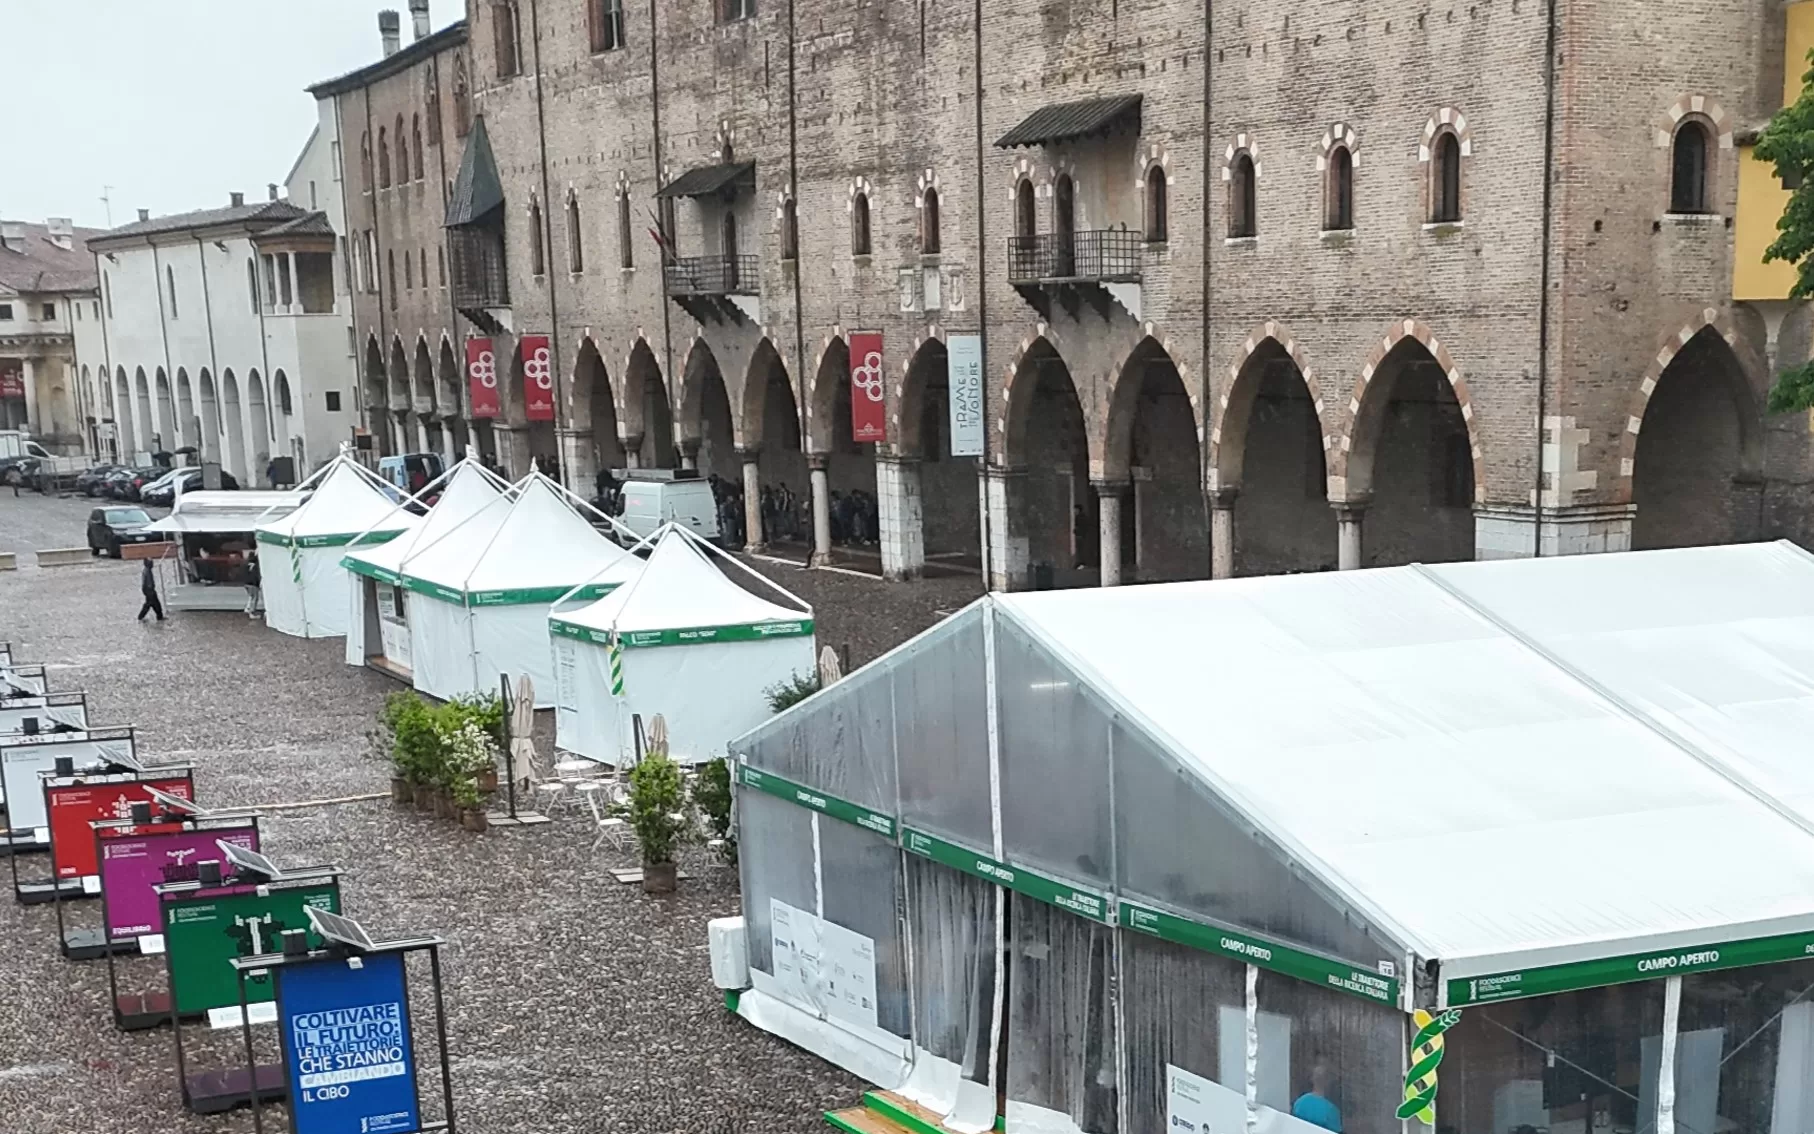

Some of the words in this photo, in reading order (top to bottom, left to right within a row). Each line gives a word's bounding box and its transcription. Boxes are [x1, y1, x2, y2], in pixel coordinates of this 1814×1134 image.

[976, 860, 995, 875] CAMPO
[994, 867, 1014, 883] APERTO
[1220, 937, 1245, 953] CAMPO
[1245, 944, 1272, 961] APERTO
[1637, 956, 1678, 972] CAMPO
[1678, 950, 1720, 967] APERTO
[295, 1004, 397, 1030] COLTIVARE
[297, 1031, 315, 1047] IL
[319, 1020, 399, 1044] FUTURO:
[298, 1047, 312, 1060] LE
[316, 1035, 401, 1057] TRAIETTORIE
[300, 1055, 333, 1074] CHE
[335, 1046, 403, 1069] STANNO
[303, 1089, 315, 1103] IL
[316, 1084, 350, 1101] CIBO
